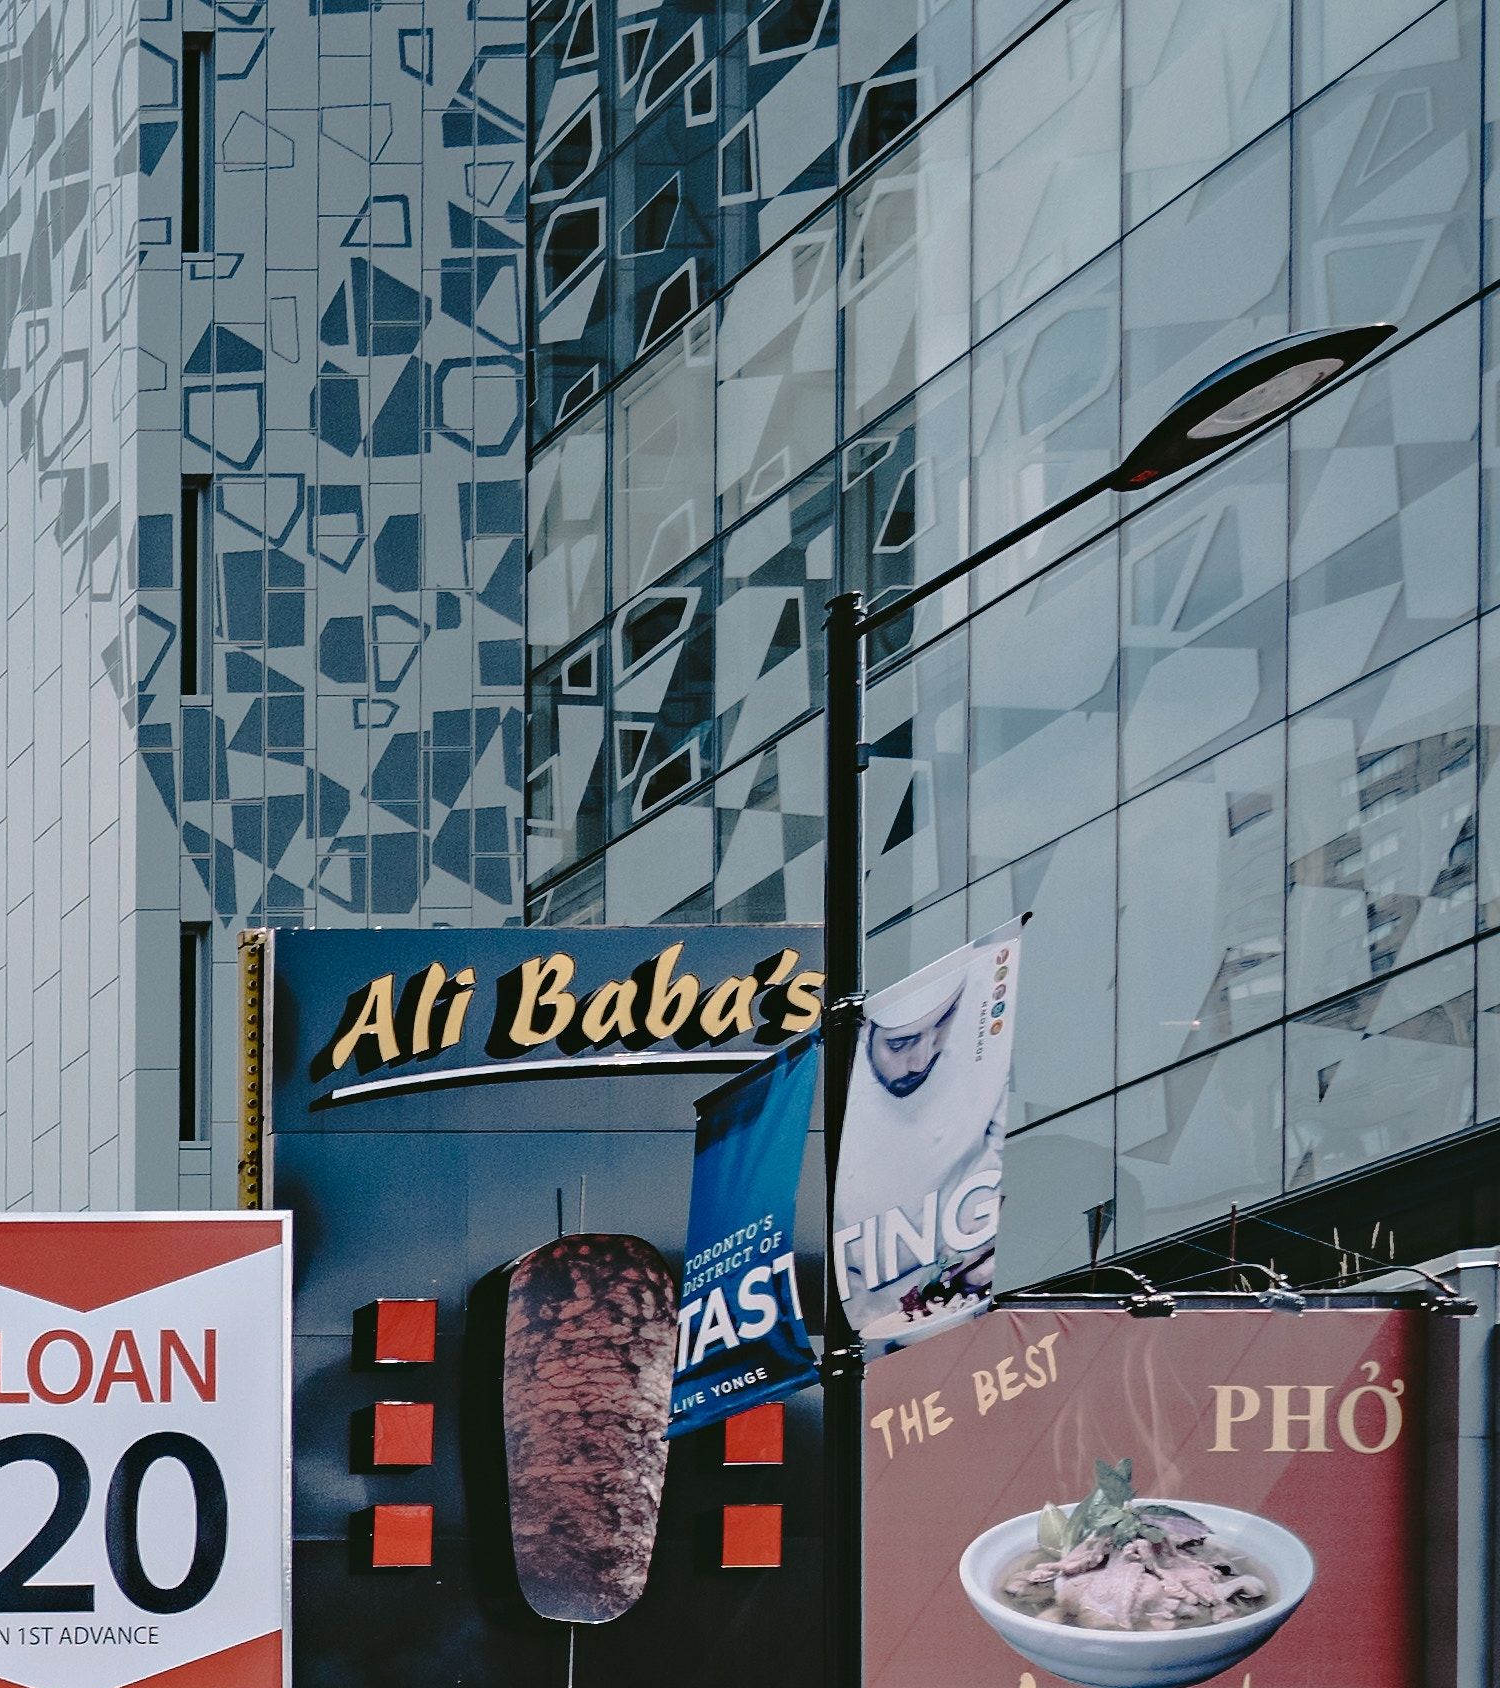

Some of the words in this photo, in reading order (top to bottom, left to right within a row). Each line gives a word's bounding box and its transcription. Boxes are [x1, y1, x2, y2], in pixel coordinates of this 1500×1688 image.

[332, 961, 475, 1071] Ali
[508, 942, 825, 1050] Baba's
[683, 1247, 753, 1298] DISTRICT
[760, 1231, 782, 1254] OF
[685, 1214, 774, 1276] TORONTO'S
[673, 1391, 706, 1414] LIVE
[711, 1367, 768, 1397] YONGE
[871, 1397, 954, 1460] THE
[972, 1332, 1060, 1416] BEST
[16, 1626, 53, 1645] 1ST
[58, 1625, 159, 1645] ADVANCE
